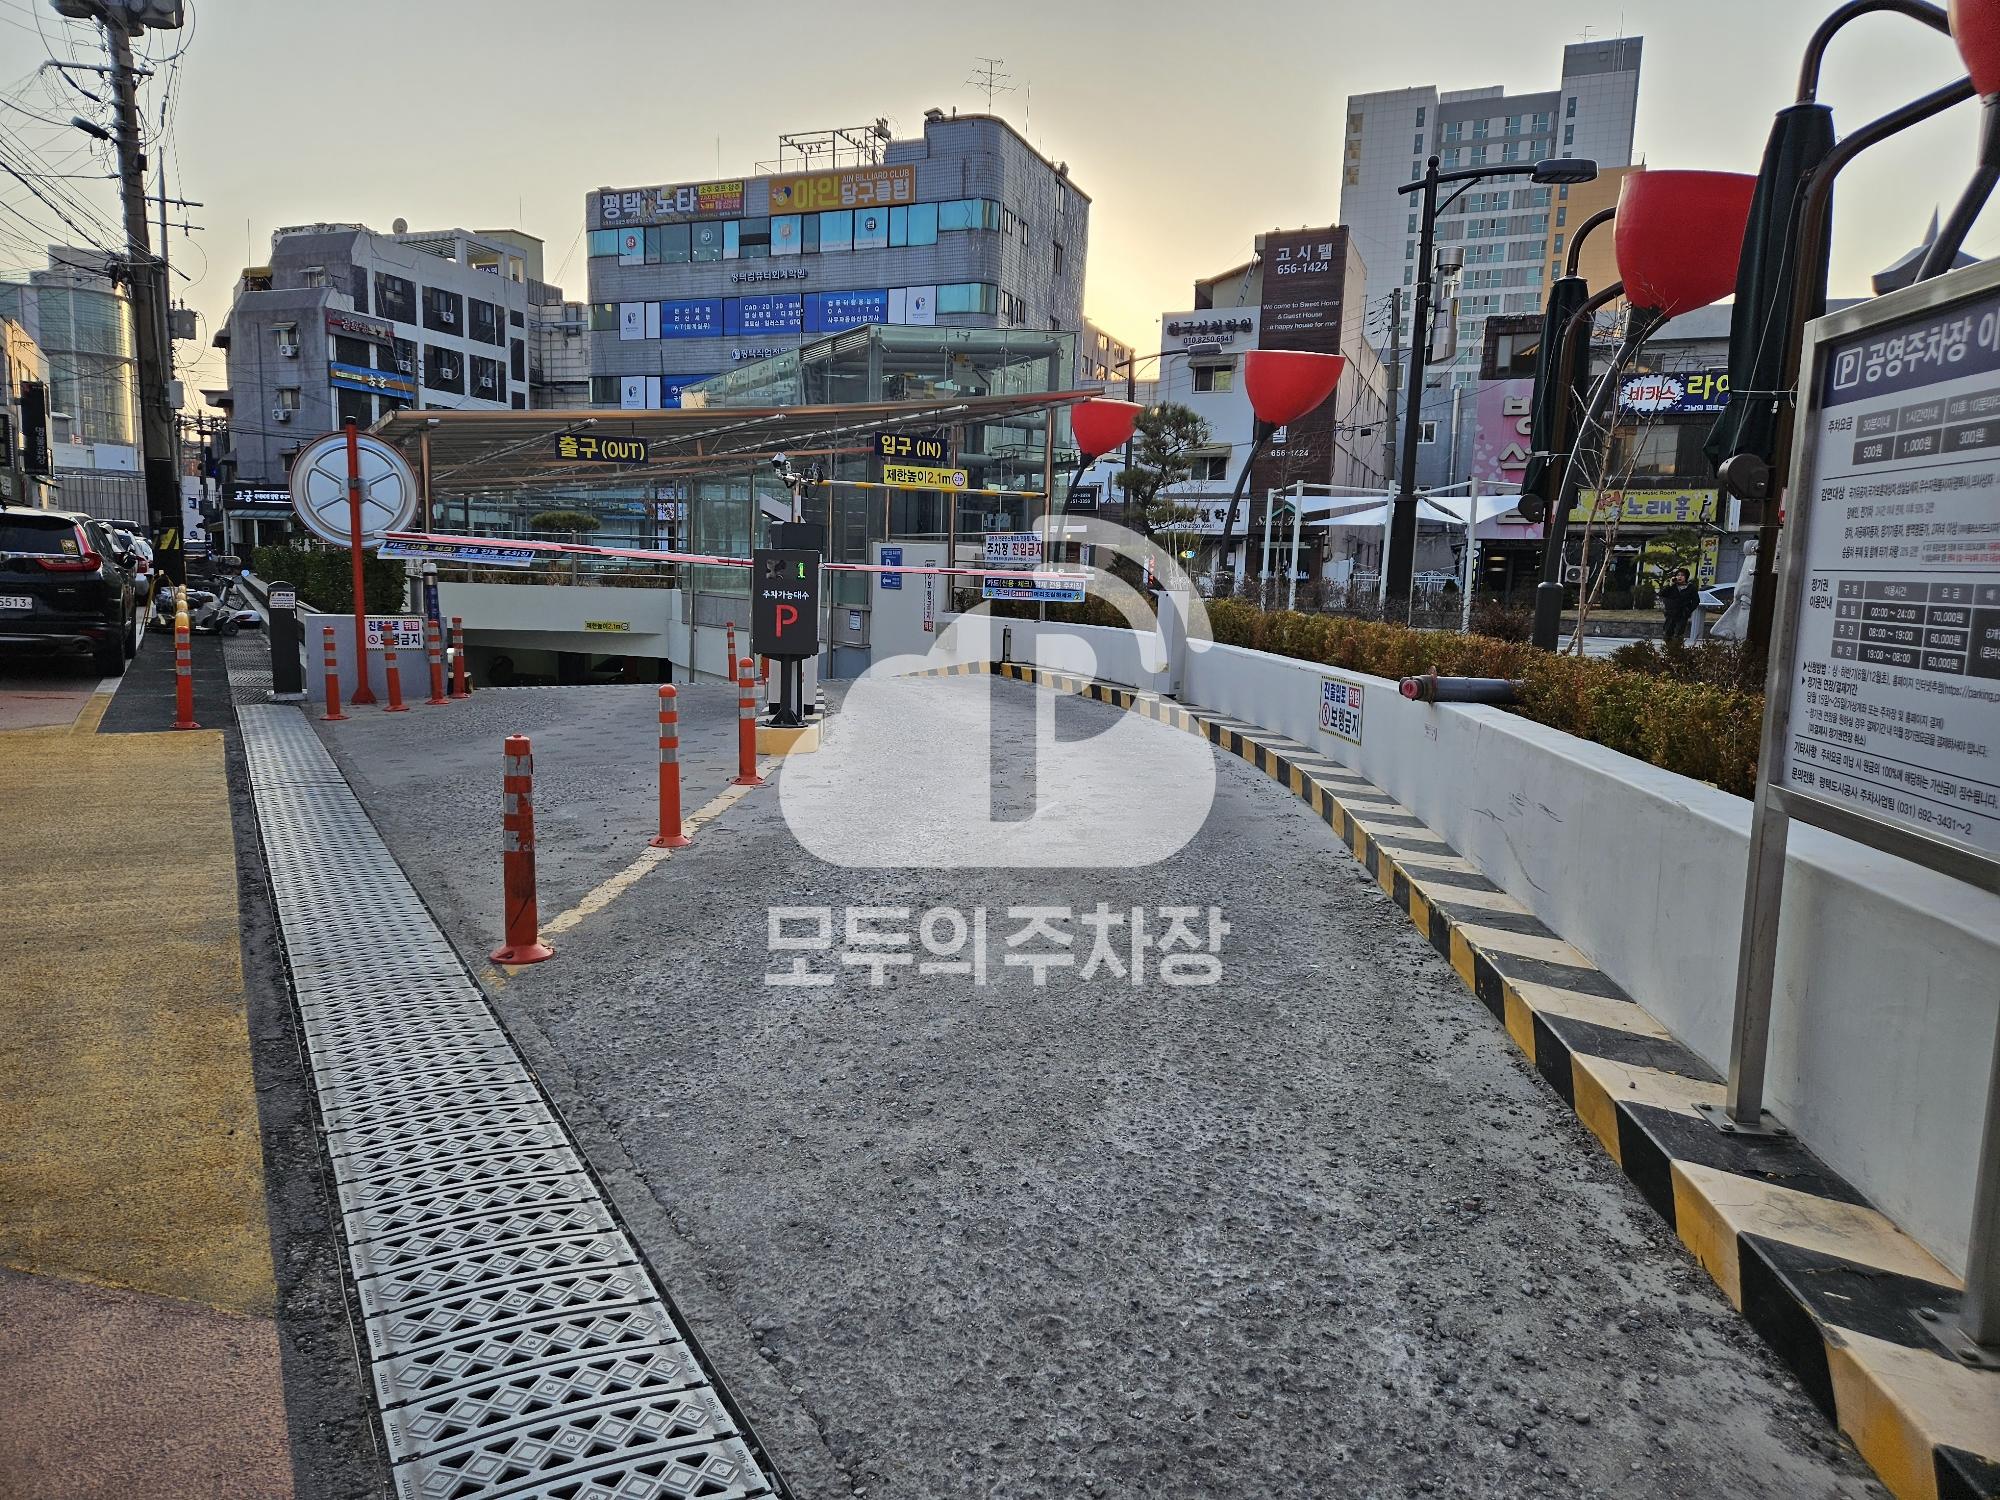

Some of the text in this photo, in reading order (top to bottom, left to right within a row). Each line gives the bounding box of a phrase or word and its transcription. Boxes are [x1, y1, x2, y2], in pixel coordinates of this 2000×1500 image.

[842, 168, 910, 183] AIN BILLIARD CLUB
[793, 175, 909, 209] 아인 당구클럽
[602, 192, 641, 219] 평택
[1276, 243, 1333, 261] 고시텔
[1277, 262, 1329, 275] 656-1424
[1865, 316, 1973, 383] 공영주차장
[1629, 385, 1676, 401] 바카스
[1827, 416, 1853, 437] 주차요금
[559, 436, 645, 461] 출구 (OUT)
[881, 435, 942, 458] 입구 (IN)
[1863, 428, 1987, 458] 500원 1,000원 300원
[234, 490, 254, 503] 고궁
[1627, 495, 1691, 520] 노래홀
[986, 542, 1009, 556] 주차장
[795, 561, 806, 579] 1
[1811, 578, 1829, 592] 정기권
[762, 590, 809, 600] 주차가능대수
[1809, 595, 1833, 610] 이용안내
[368, 620, 400, 631] 진출로
[775, 604, 798, 638] P
[1896, 609, 1916, 620] 24:00
[1933, 611, 1964, 624] 70,000원
[1868, 627, 1886, 638] 08:00
[1895, 629, 1913, 641] 19:00
[1866, 649, 1884, 660] 19:00
[1892, 652, 1911, 664] 08:00
[1927, 656, 1959, 670] 50,000원
[1807, 676, 1822, 690] 정기권
[1324, 681, 1360, 708] 진출입로 위험
[1330, 706, 1360, 738] 보행금지
[1793, 741, 1817, 759] 기타사항
[1820, 749, 1842, 764] 주차요금
[1791, 767, 1972, 835] 문의전화 평택도시공사 주차사업팀 (031) 692-3431~2
